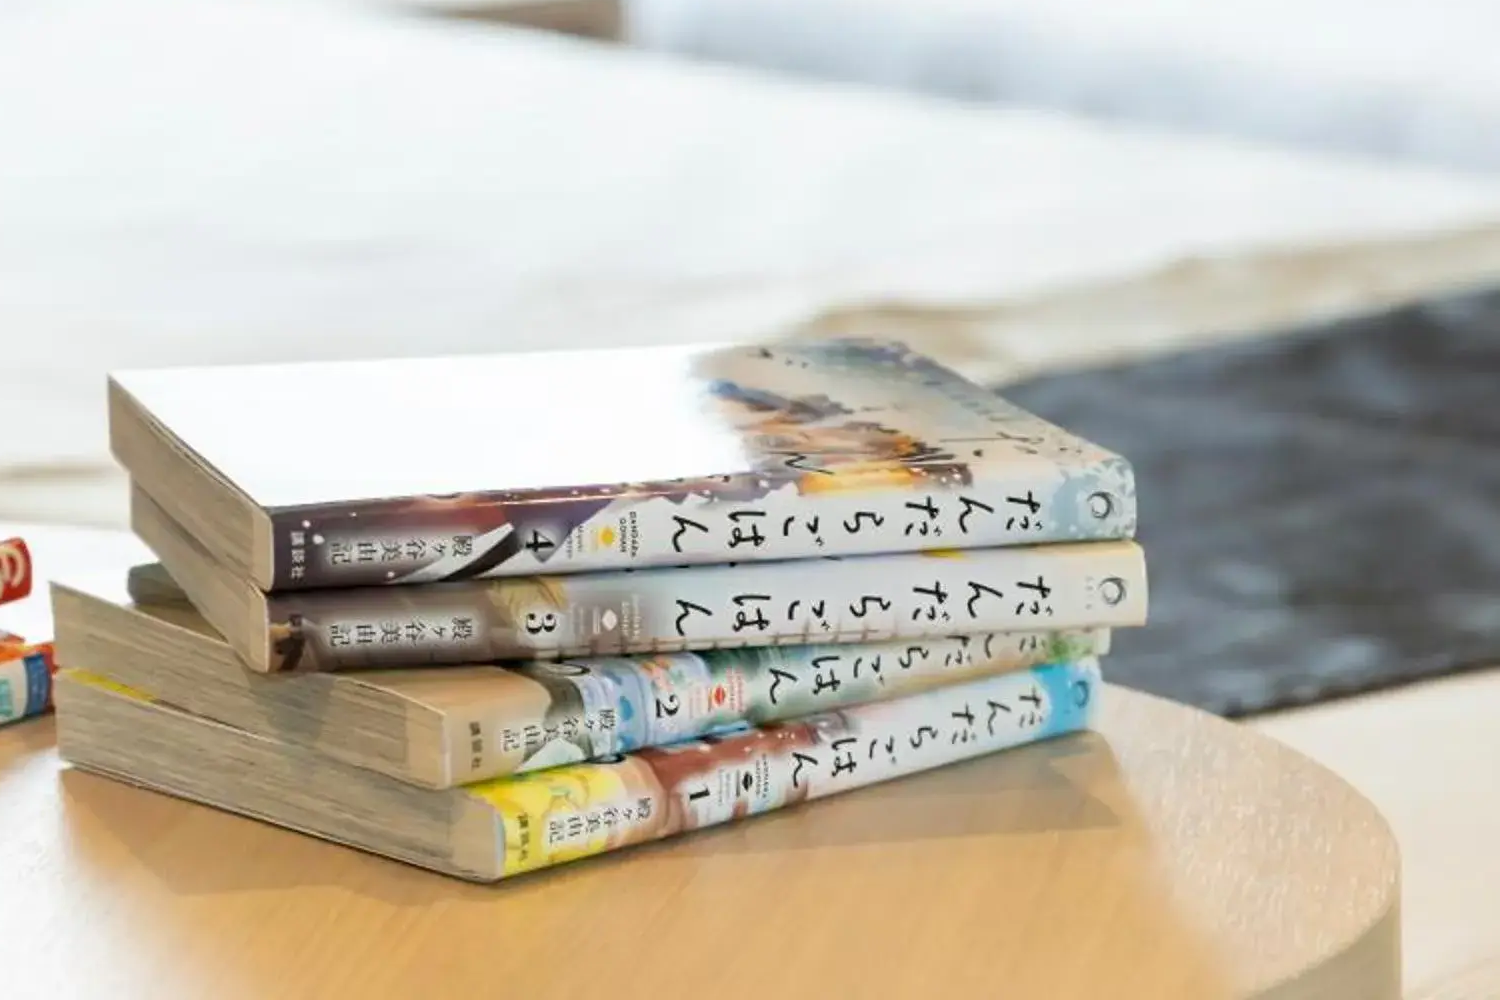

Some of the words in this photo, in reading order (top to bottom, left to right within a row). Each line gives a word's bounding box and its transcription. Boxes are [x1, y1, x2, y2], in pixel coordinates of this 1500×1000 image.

[672, 492, 1043, 553] だんだらごはん
[525, 529, 555, 553] 4
[675, 576, 1053, 636] だんだらごはん
[526, 612, 557, 635] 3
[655, 694, 679, 720] 2
[792, 687, 1043, 788] だんだらごはん
[689, 786, 711, 801] 1
